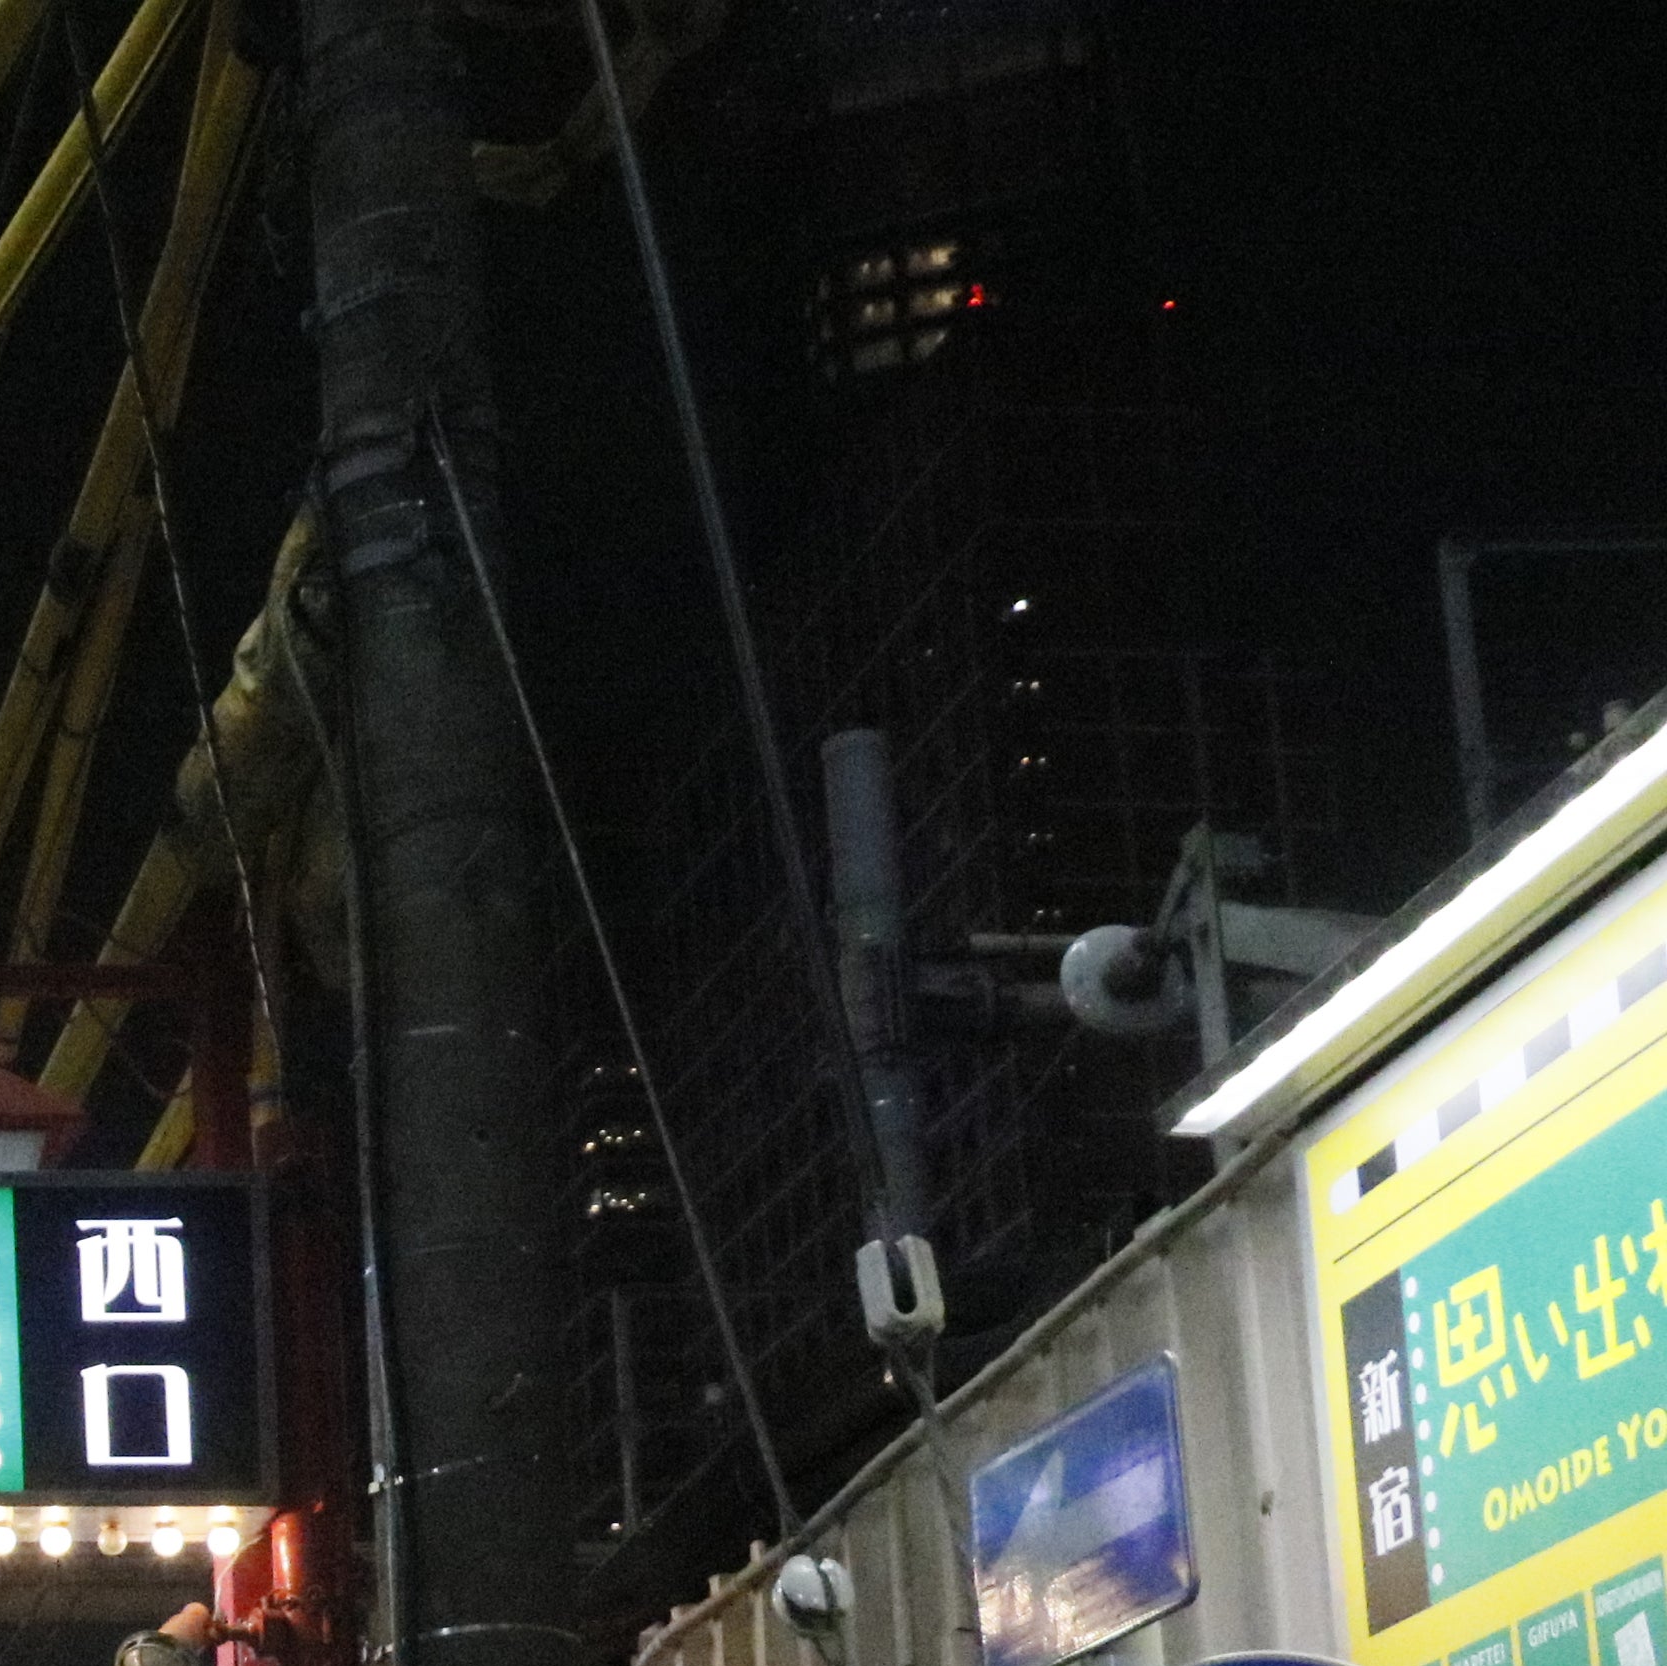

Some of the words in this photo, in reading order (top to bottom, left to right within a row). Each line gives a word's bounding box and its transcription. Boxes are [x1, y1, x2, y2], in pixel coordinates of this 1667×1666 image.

[75, 1217, 193, 1466] 西口
[1359, 1349, 1414, 1556] 新宿
[1483, 1435, 1612, 1532] OMOIDE
[1527, 1608, 1580, 1649] GIFUYA
